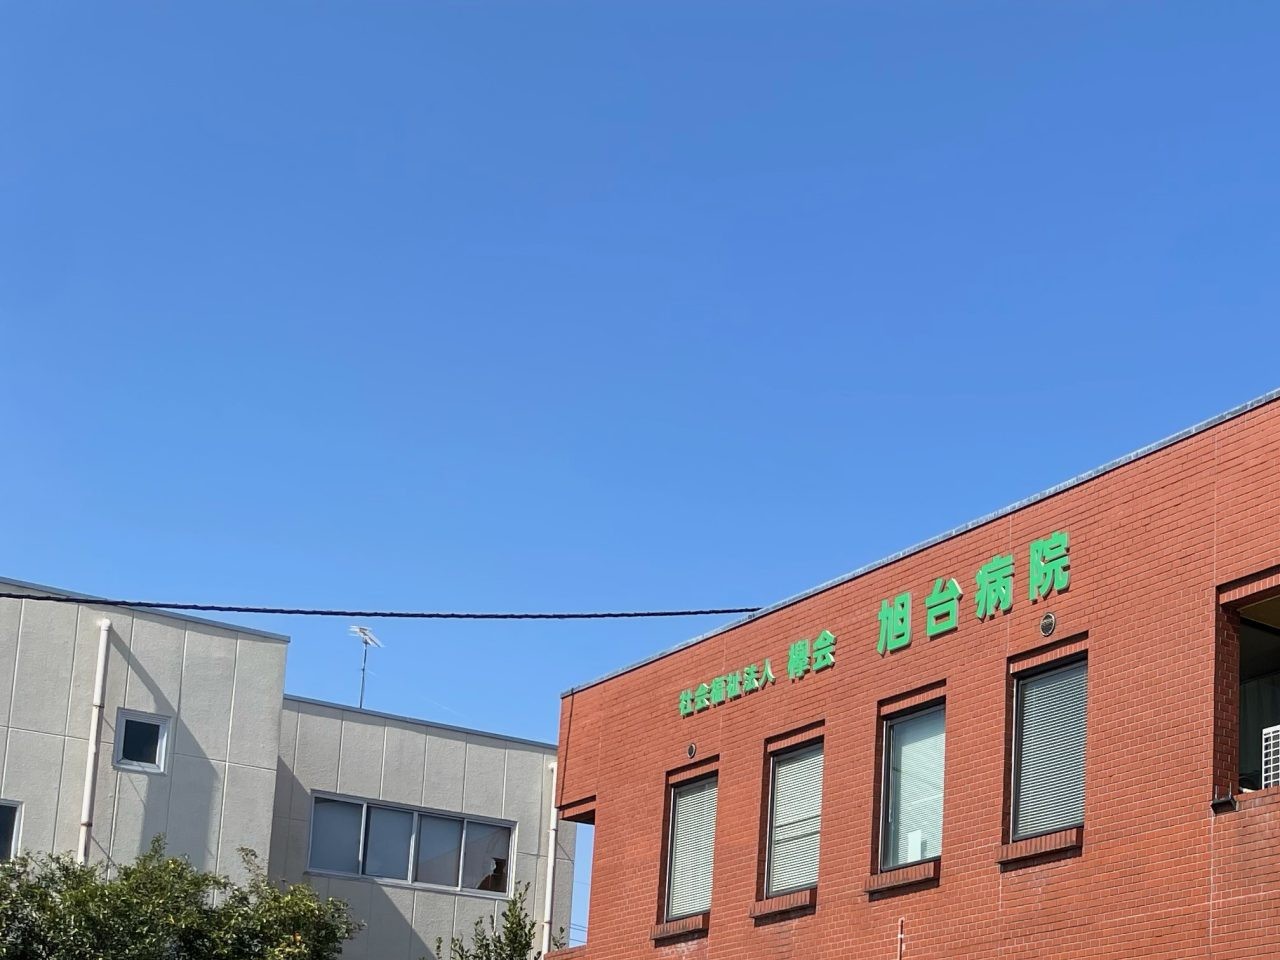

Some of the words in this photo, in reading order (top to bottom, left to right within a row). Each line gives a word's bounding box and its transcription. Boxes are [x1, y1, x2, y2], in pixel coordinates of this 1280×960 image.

[678, 658, 775, 717] 社会福祉法人
[876, 531, 1070, 656] 旭台病院
